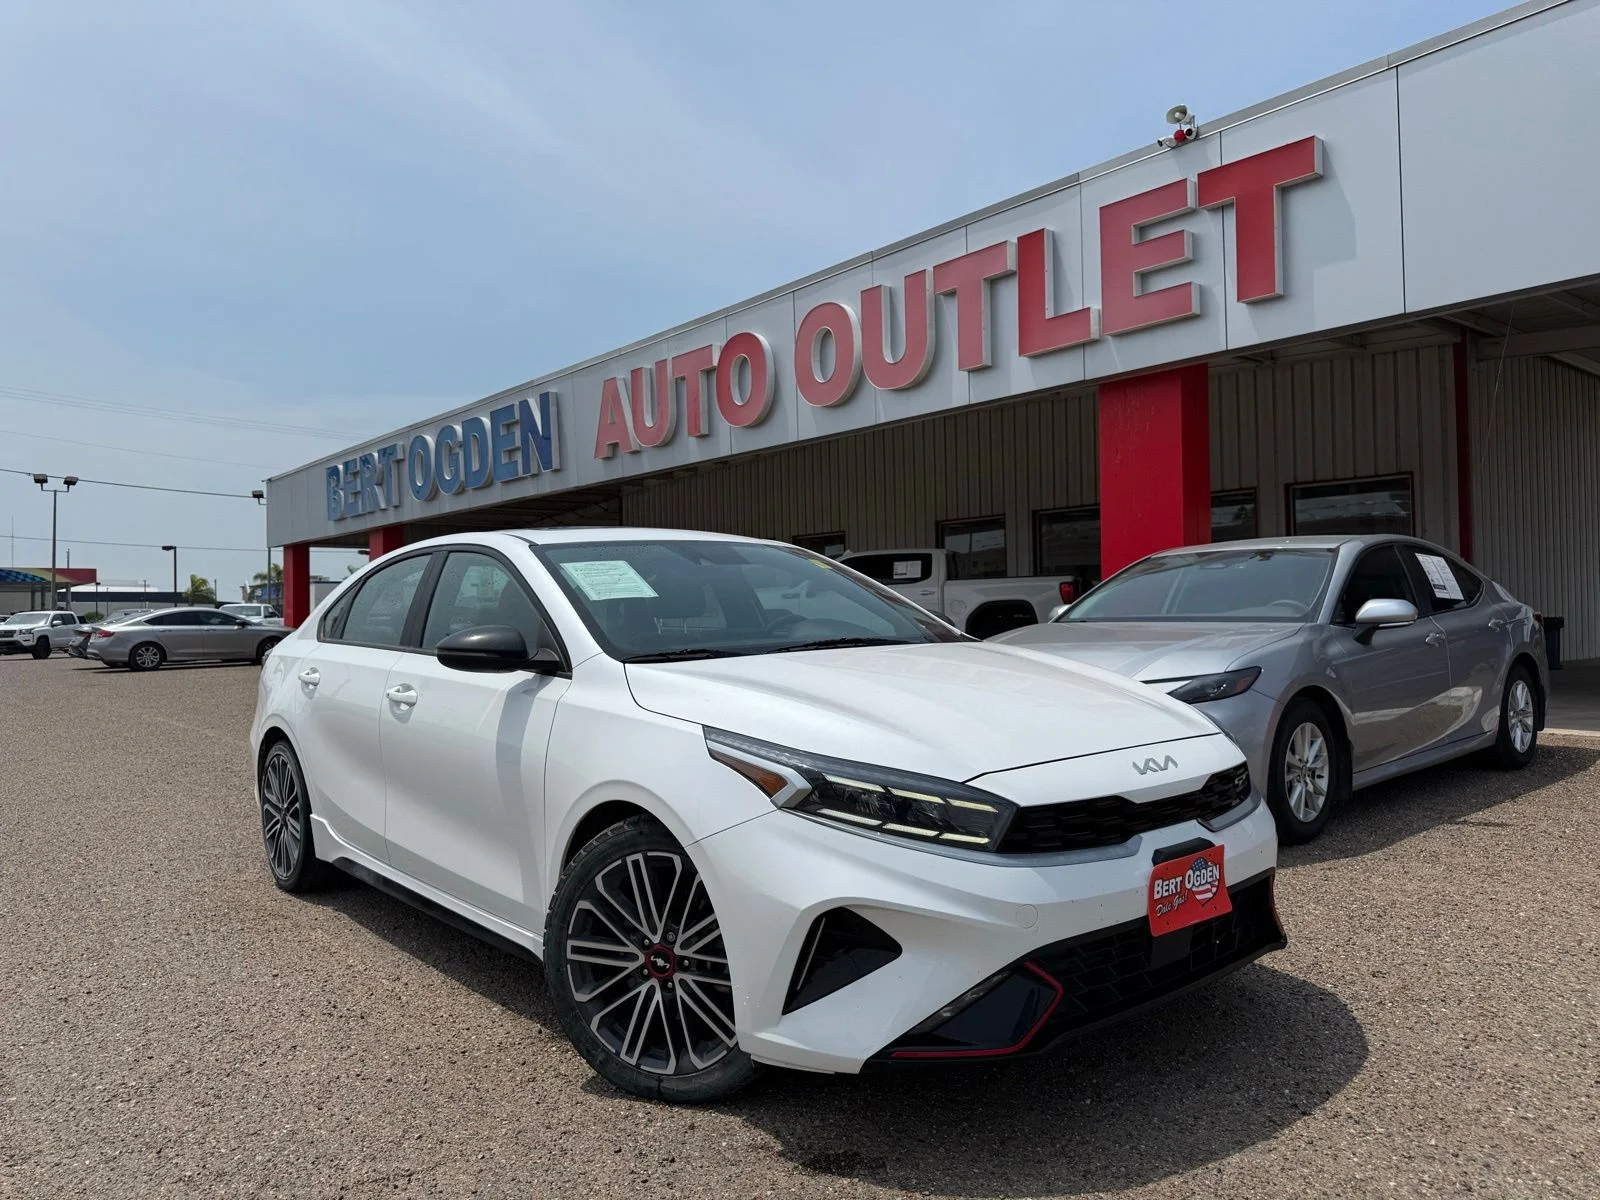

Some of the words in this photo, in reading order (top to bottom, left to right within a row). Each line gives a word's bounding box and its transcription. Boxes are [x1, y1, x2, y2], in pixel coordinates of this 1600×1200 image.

[326, 443, 404, 520] BERT
[408, 391, 560, 501] OGDEN
[594, 332, 775, 459] AUTO
[795, 135, 1323, 407] OUTLET
[1154, 876, 1183, 900] BERT
[1185, 864, 1220, 889] OGDEN
